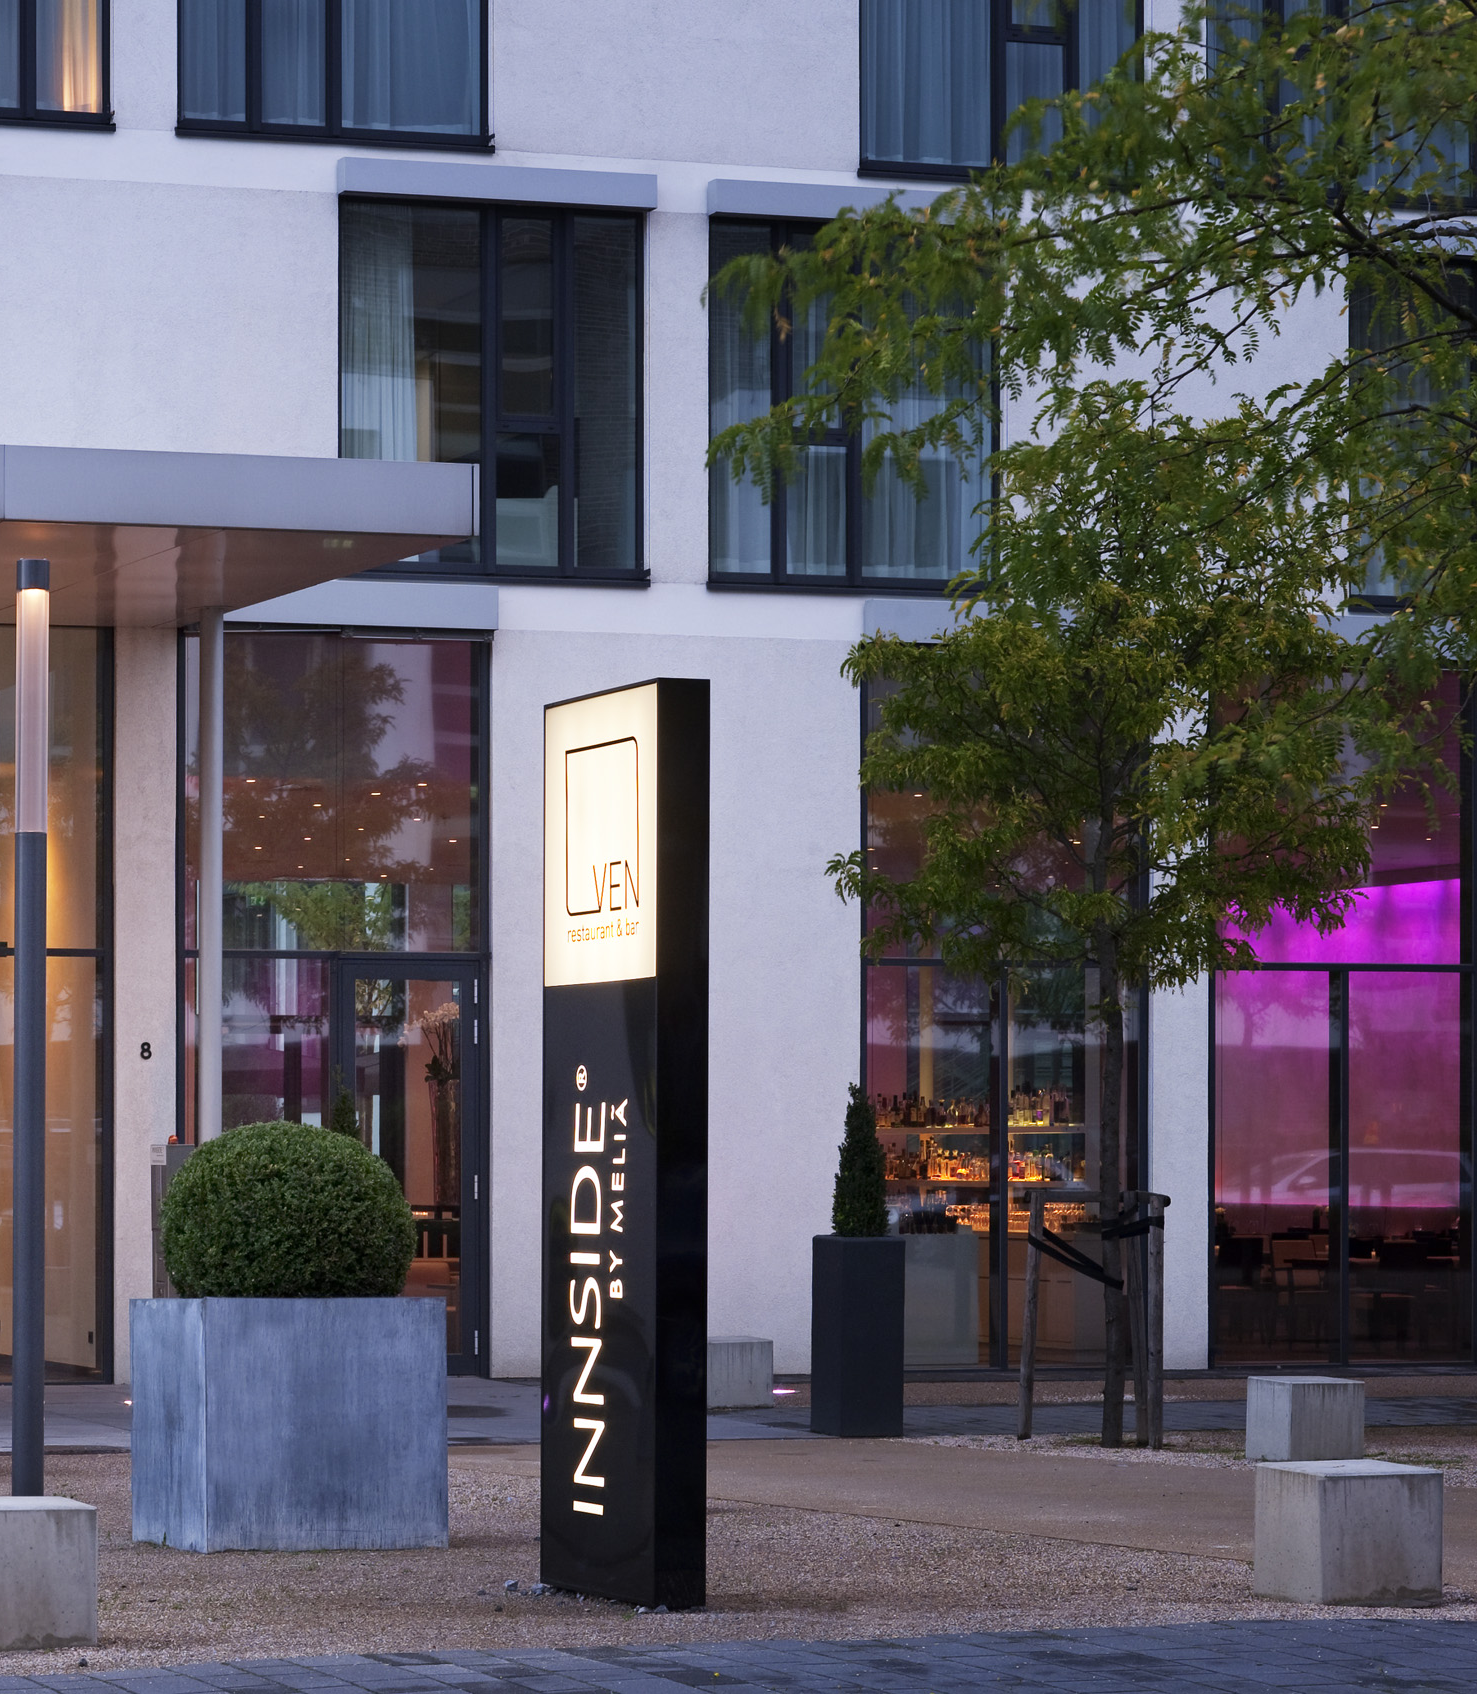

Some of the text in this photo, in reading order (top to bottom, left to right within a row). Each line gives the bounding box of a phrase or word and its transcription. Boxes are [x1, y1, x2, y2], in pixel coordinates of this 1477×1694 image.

[567, 917, 640, 943] restaurant & bar
[140, 1041, 153, 1060] 8
[609, 1249, 624, 1299] BY
